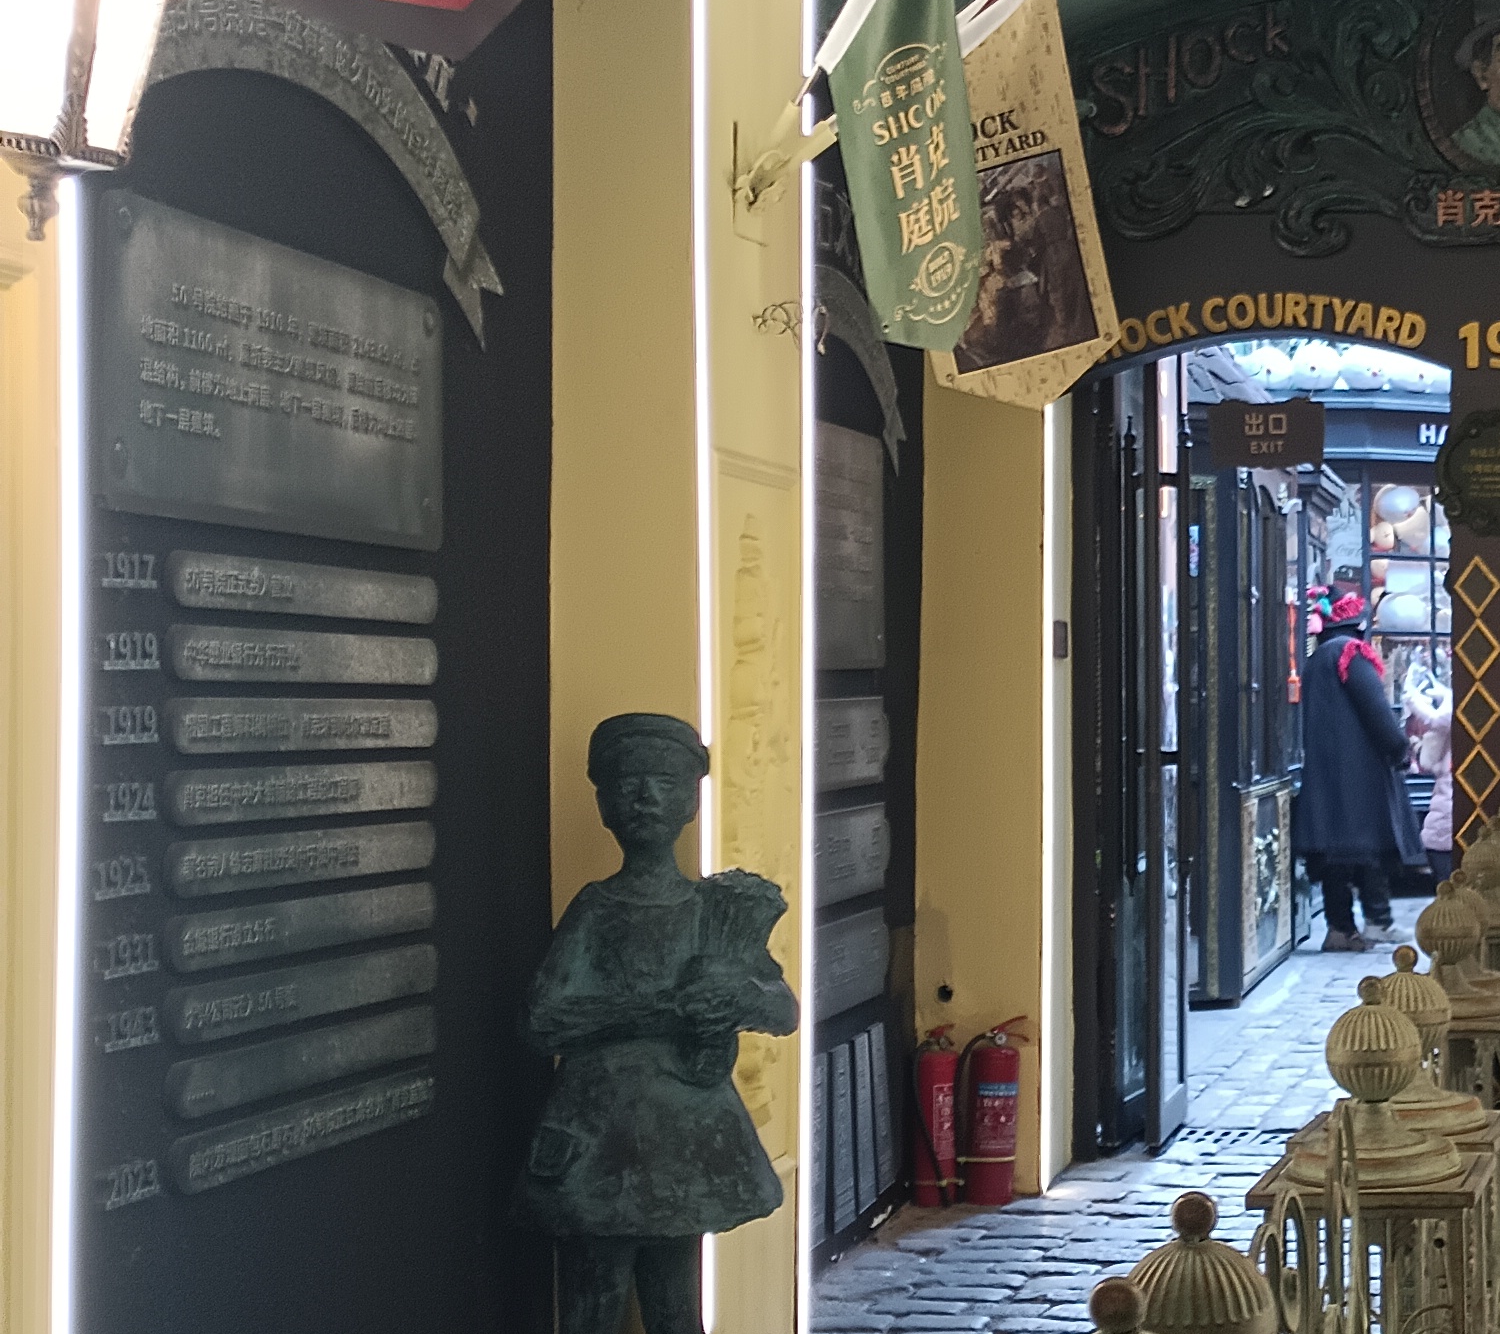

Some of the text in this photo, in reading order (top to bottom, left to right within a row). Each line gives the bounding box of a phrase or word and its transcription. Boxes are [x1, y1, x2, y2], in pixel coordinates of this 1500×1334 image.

[1112, 292, 1428, 359] OCK COURTYARD
[1244, 413, 1288, 436] 出口
[1250, 441, 1285, 454] EXIT
[105, 551, 156, 579] 1917
[107, 632, 158, 662] 1919
[107, 704, 157, 734] 1919
